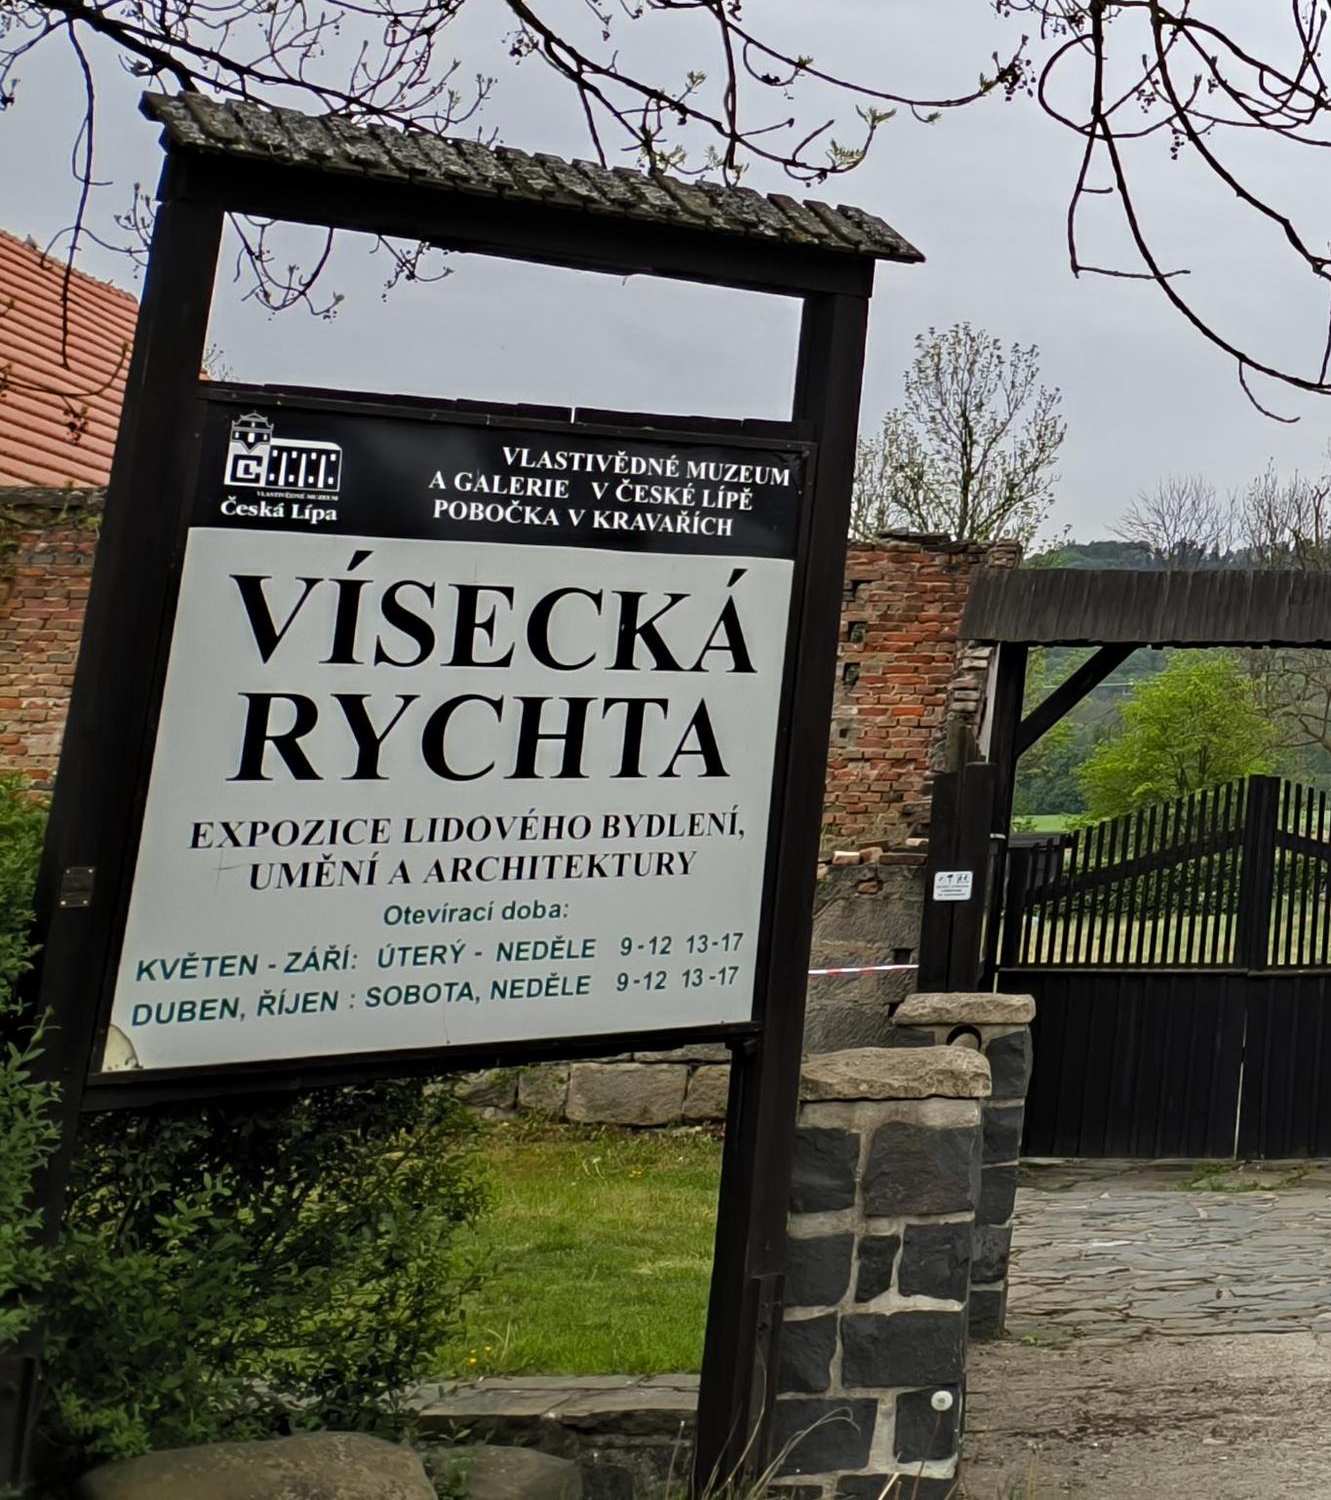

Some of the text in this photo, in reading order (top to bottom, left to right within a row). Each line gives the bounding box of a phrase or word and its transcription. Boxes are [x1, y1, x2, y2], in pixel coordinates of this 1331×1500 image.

[503, 447, 790, 487] VLASTIVĚDNÉ MUZEUM
[220, 496, 337, 524] Česká Lípa
[429, 470, 753, 511] A GALERIE V ČESKÉ LÍPĚ
[433, 499, 733, 536] POBOČKA V KRAVAŘÍCH
[228, 550, 758, 674] VÍSECKÁ
[225, 691, 732, 782] RYCHTA
[188, 804, 745, 849] EXPOZICE LIDOVÉHO BYDLENÍ,
[249, 851, 697, 890] UMĚNÍ A ARCHITEKTURY
[383, 900, 569, 926] Otevírací doba:
[135, 952, 259, 982] KVĚTEN
[283, 944, 358, 974] ZÁŘÍ:
[377, 938, 467, 969] ÚTERÝ
[496, 935, 597, 962] NEDĚLE
[619, 935, 673, 957] 9-12
[685, 932, 744, 954] 13-17
[131, 997, 246, 1027] DUBEN,
[256, 988, 339, 1017] ŘÍJEN
[364, 981, 481, 1009] SOBOTA,
[490, 972, 591, 1000] NEDĚLE
[616, 970, 667, 992] 9-12
